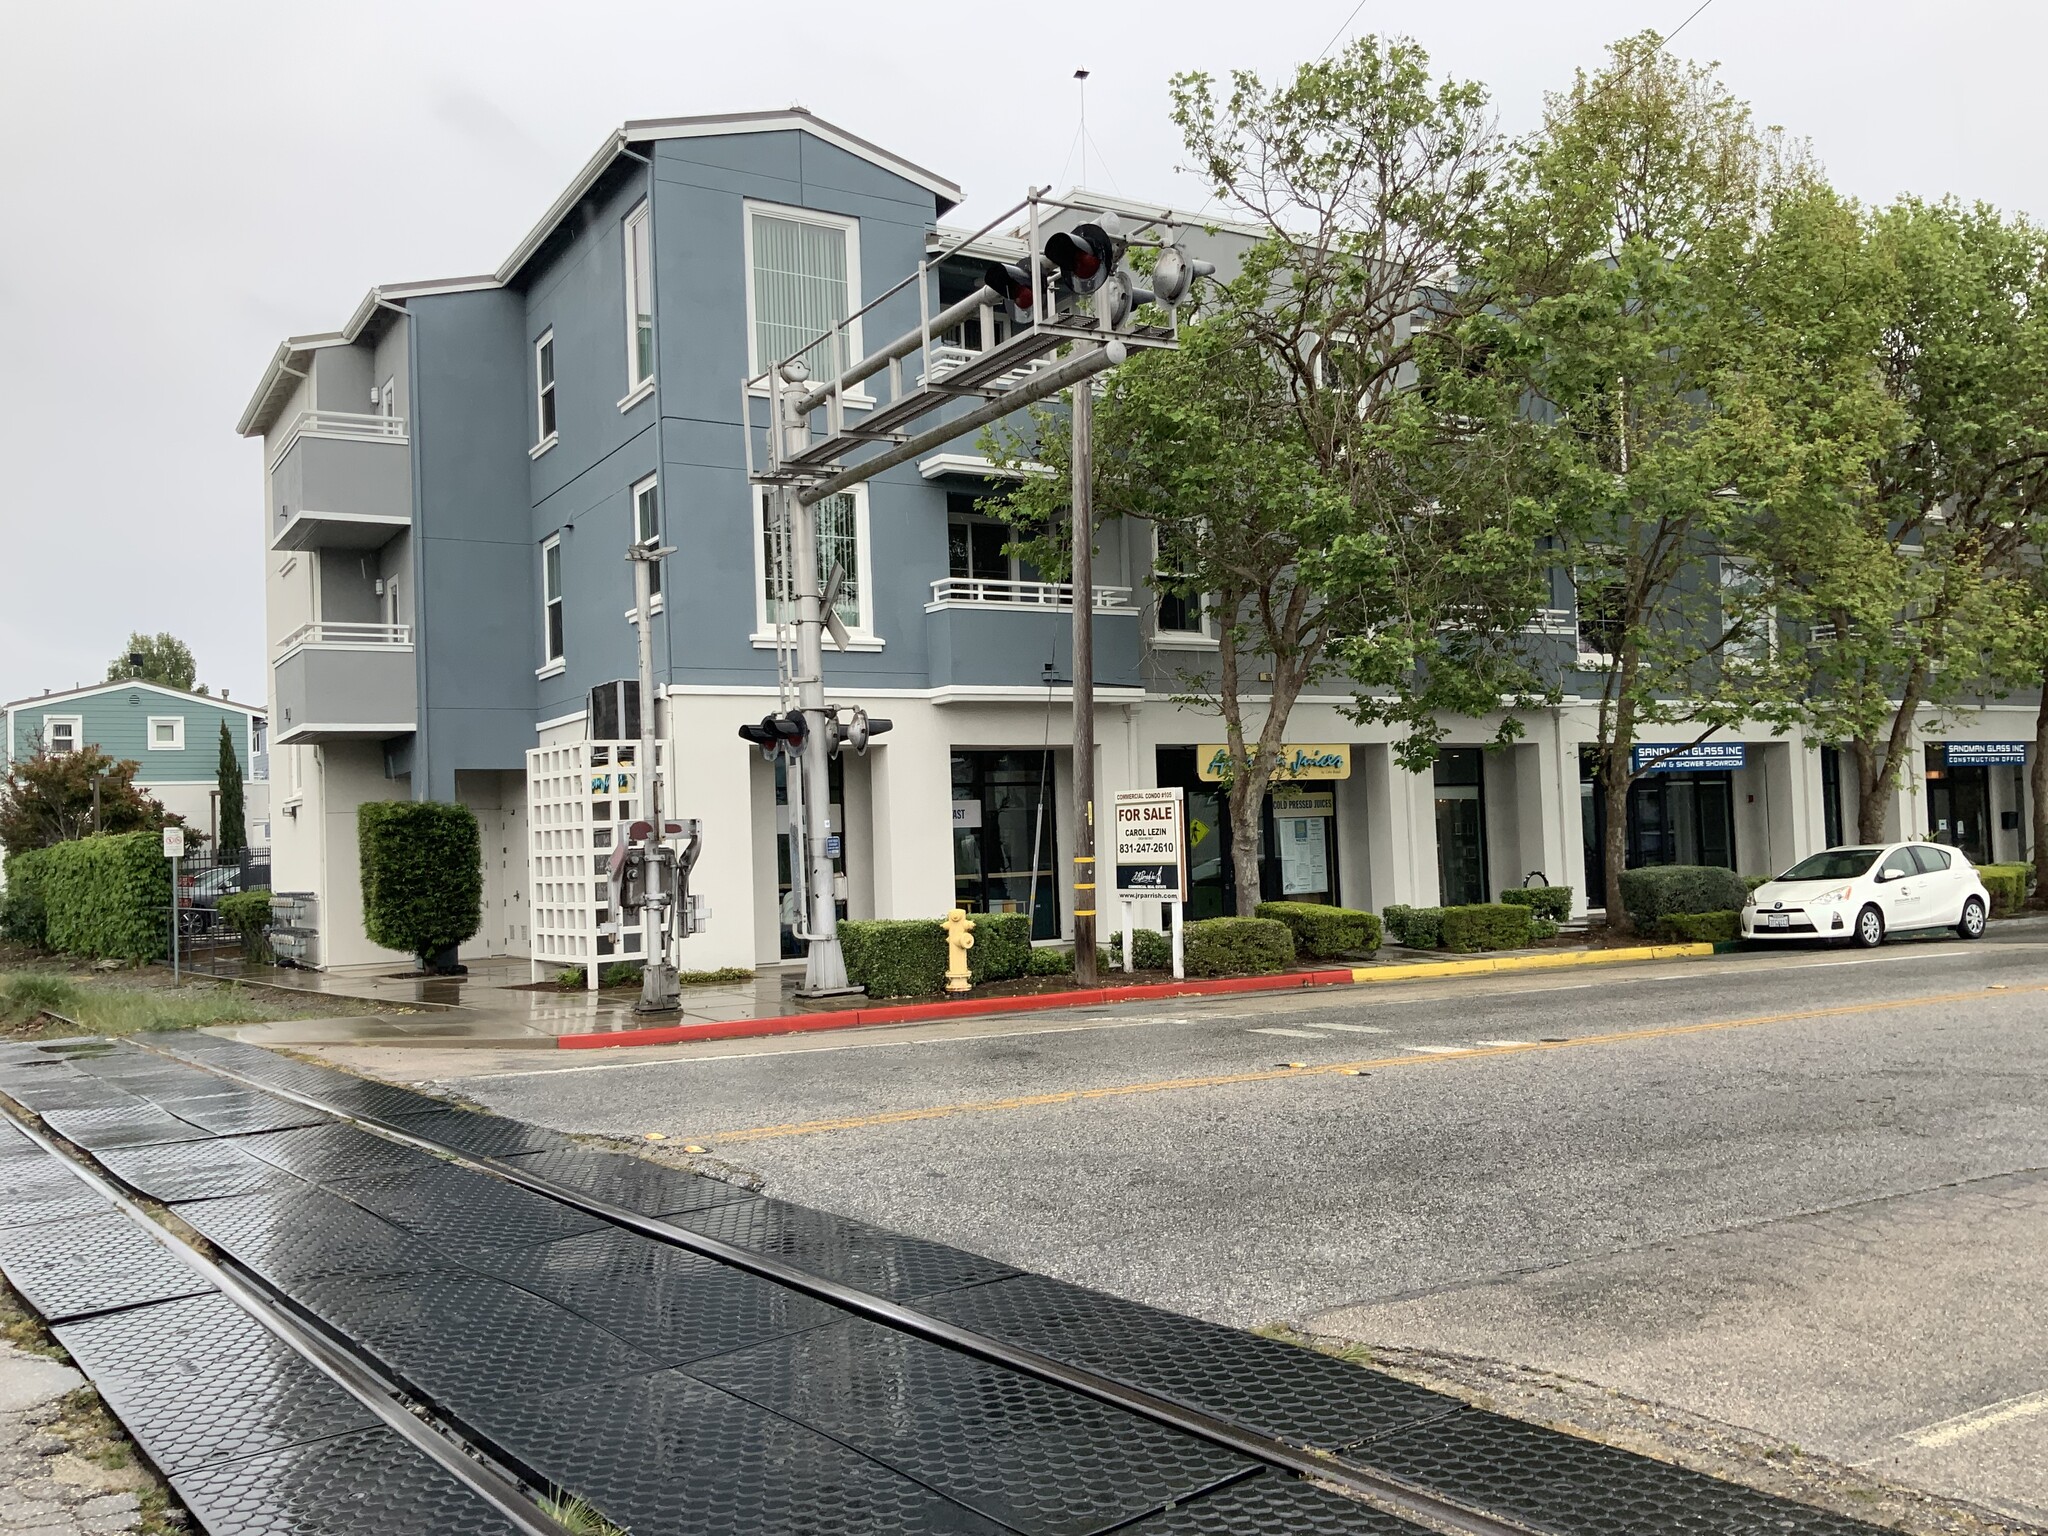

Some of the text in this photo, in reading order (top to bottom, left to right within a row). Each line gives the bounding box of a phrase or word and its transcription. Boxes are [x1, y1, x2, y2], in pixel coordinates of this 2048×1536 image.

[1691, 746, 1723, 755] GLASS
[1725, 746, 1742, 755] INC
[2012, 744, 2024, 752] INC
[1273, 800, 1332, 809] COLD PRESSED JUICES
[1119, 807, 1172, 822] FOR SALE
[1125, 828, 1167, 837] CAROL LEZIN
[1119, 842, 1174, 853] 831-247-2610
[1119, 892, 1178, 900] www.jrparrish.com
